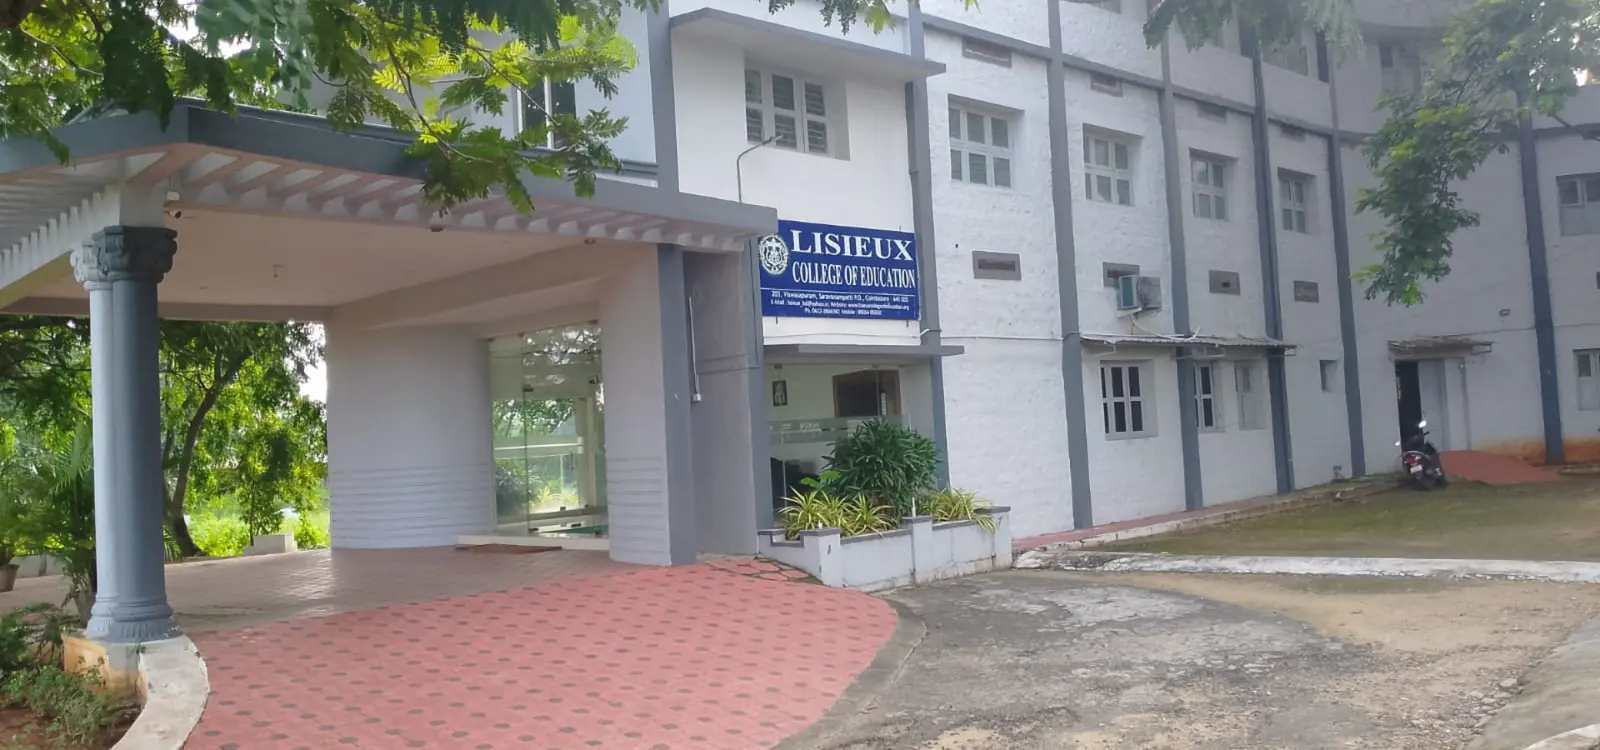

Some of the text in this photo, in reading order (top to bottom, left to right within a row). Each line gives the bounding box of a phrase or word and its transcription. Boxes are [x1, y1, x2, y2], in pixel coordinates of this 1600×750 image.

[789, 229, 914, 261] LISIEUX
[792, 261, 916, 289] COLLEGE OF EDUCATION
